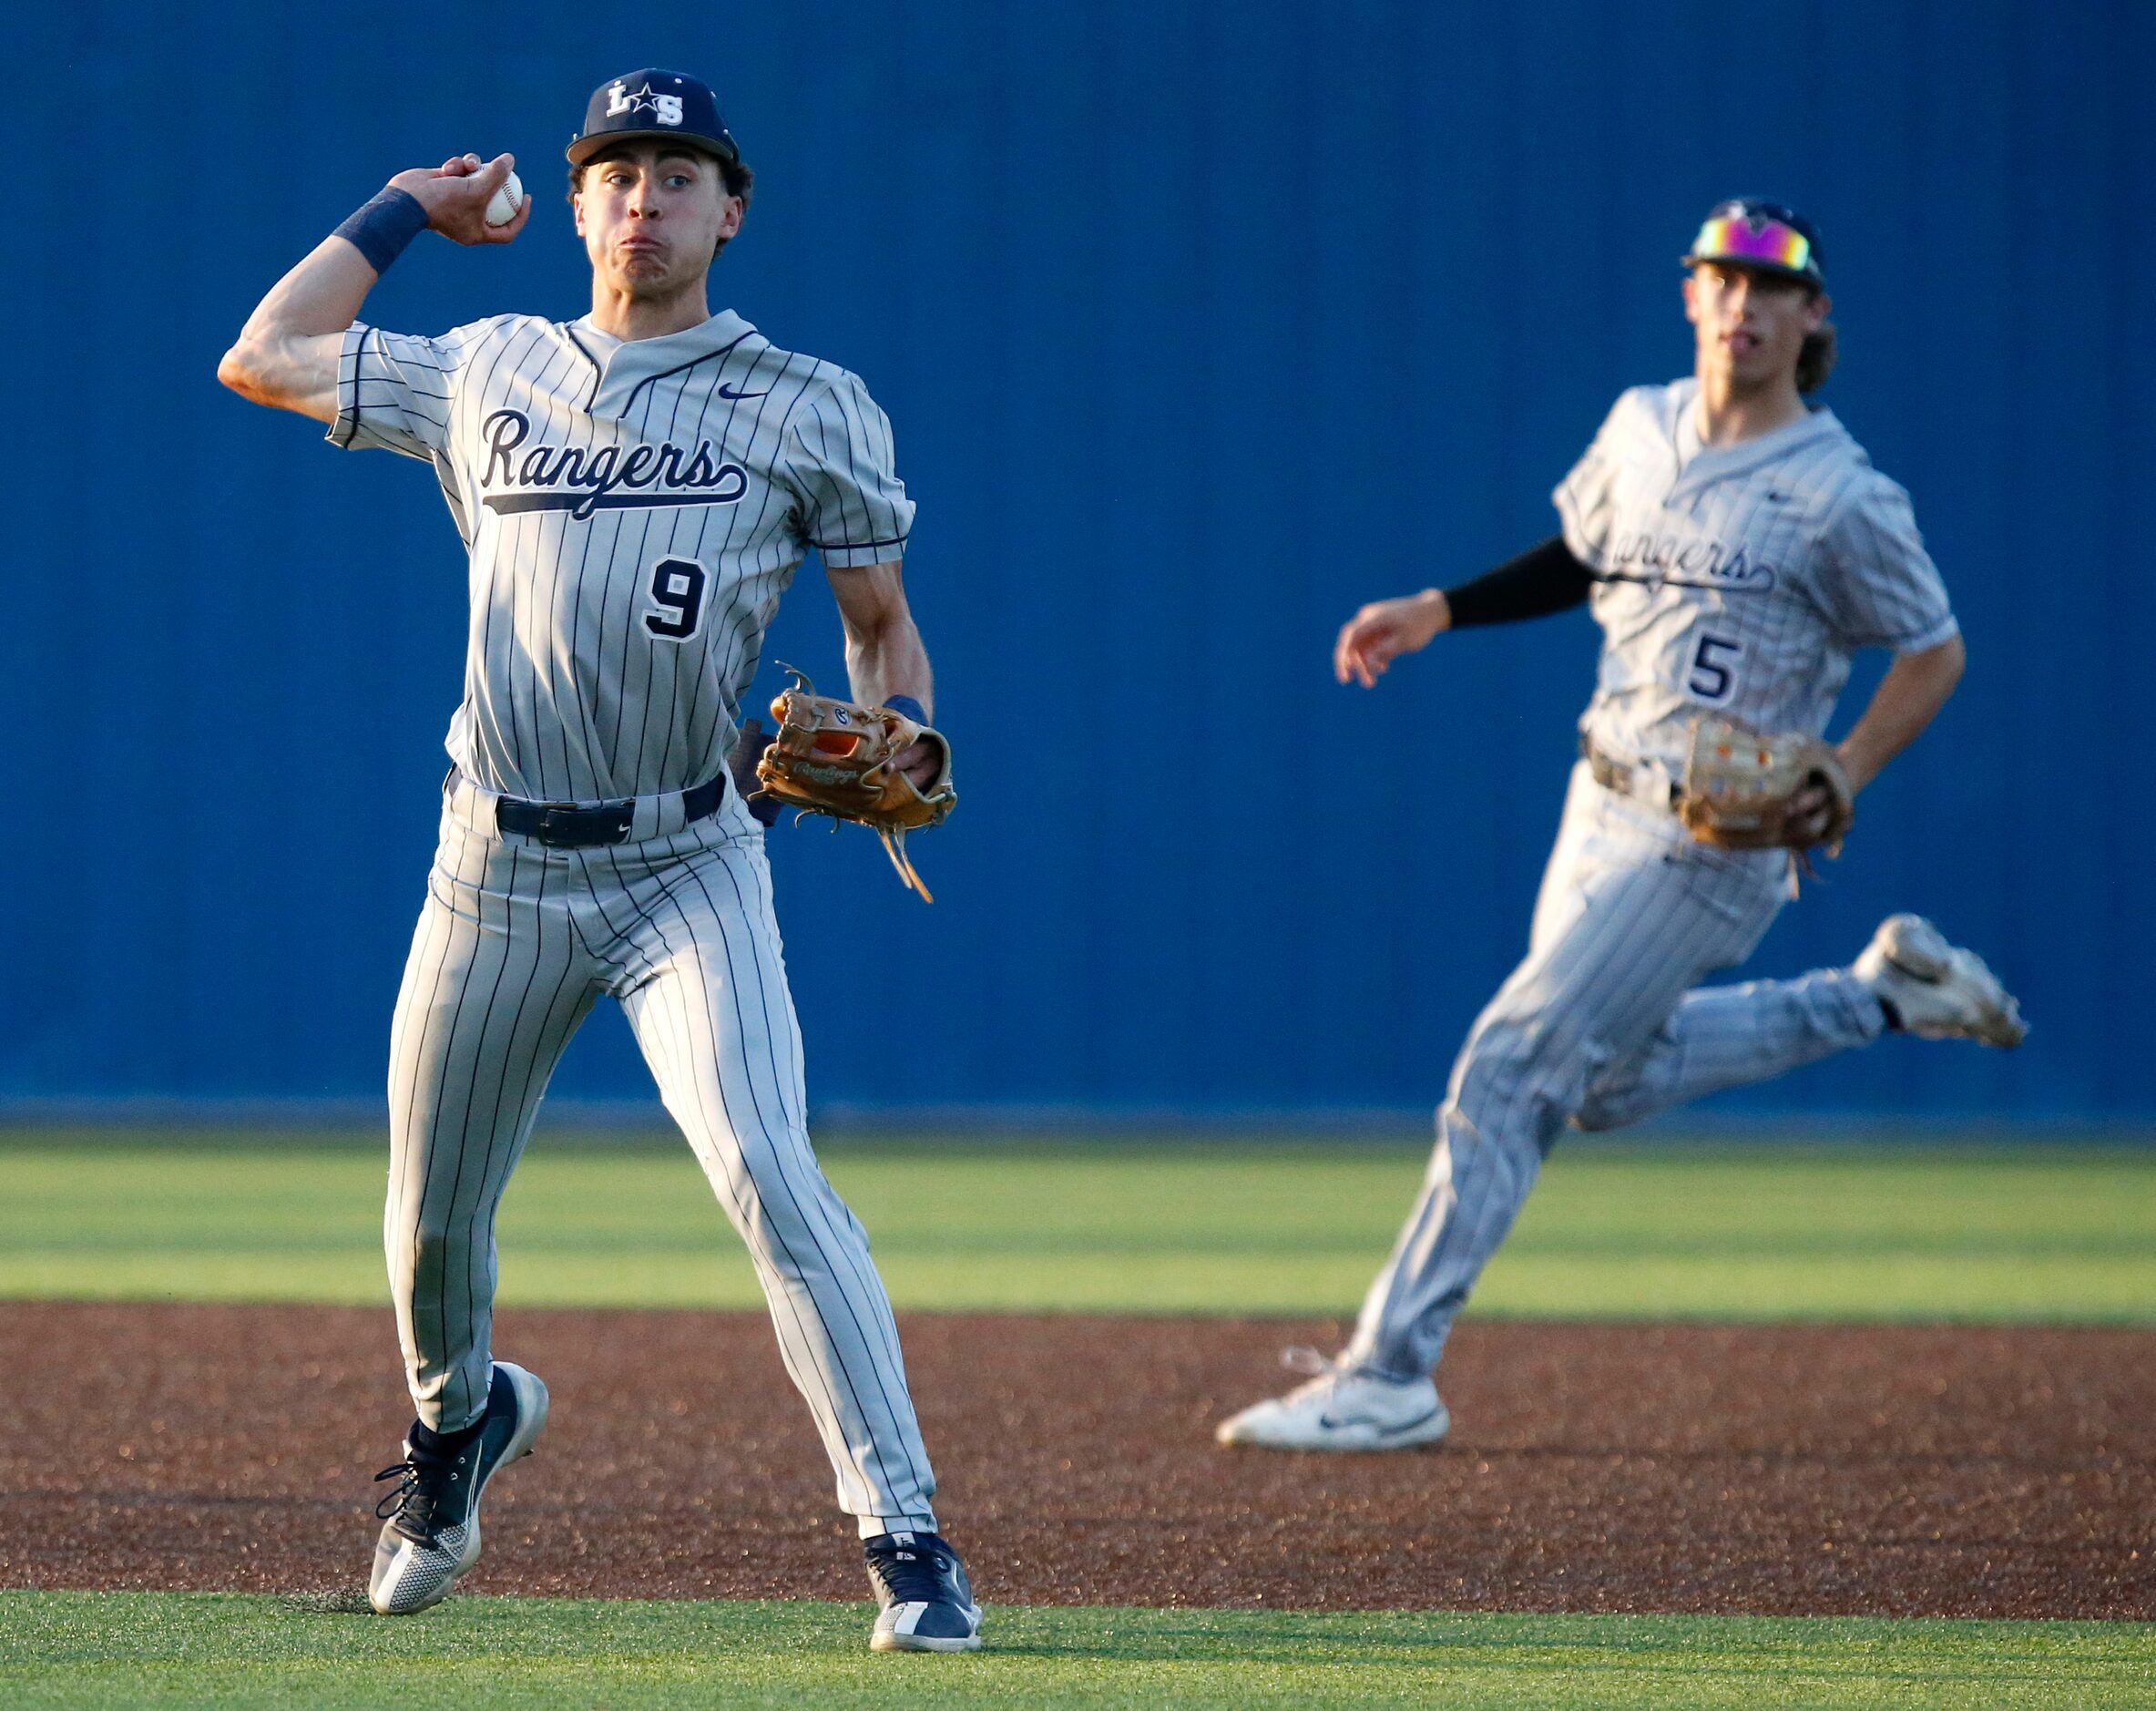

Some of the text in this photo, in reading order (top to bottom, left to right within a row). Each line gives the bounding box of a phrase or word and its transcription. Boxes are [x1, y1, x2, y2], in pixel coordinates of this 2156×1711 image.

[482, 409, 749, 521] Rangers
[643, 556, 710, 642] 9
[1687, 631, 1742, 702] 5
